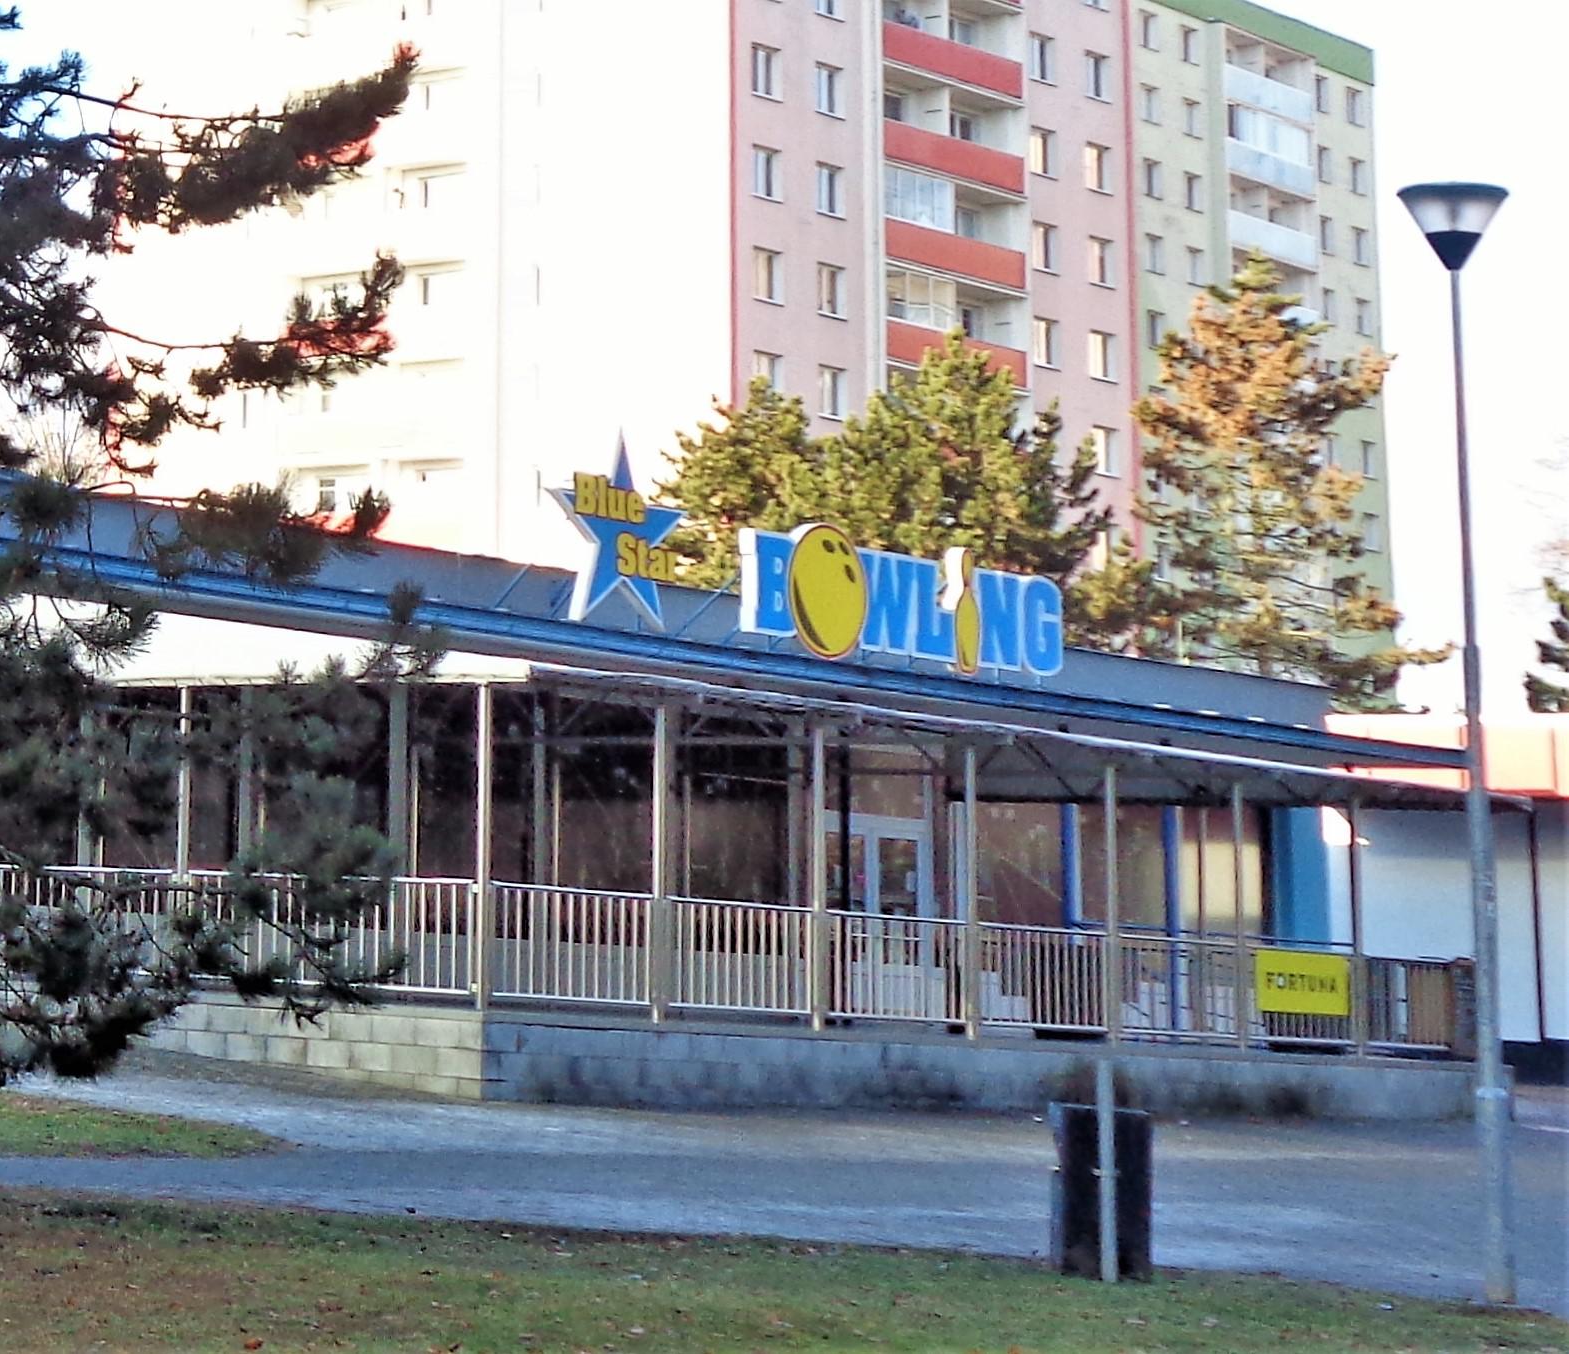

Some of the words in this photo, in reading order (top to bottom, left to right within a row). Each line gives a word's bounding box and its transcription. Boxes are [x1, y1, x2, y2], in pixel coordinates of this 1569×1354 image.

[574, 471, 646, 525] Blue
[616, 531, 677, 584] Star
[738, 523, 1063, 676] BOWLING
[1266, 972, 1338, 994] FORTUNA
